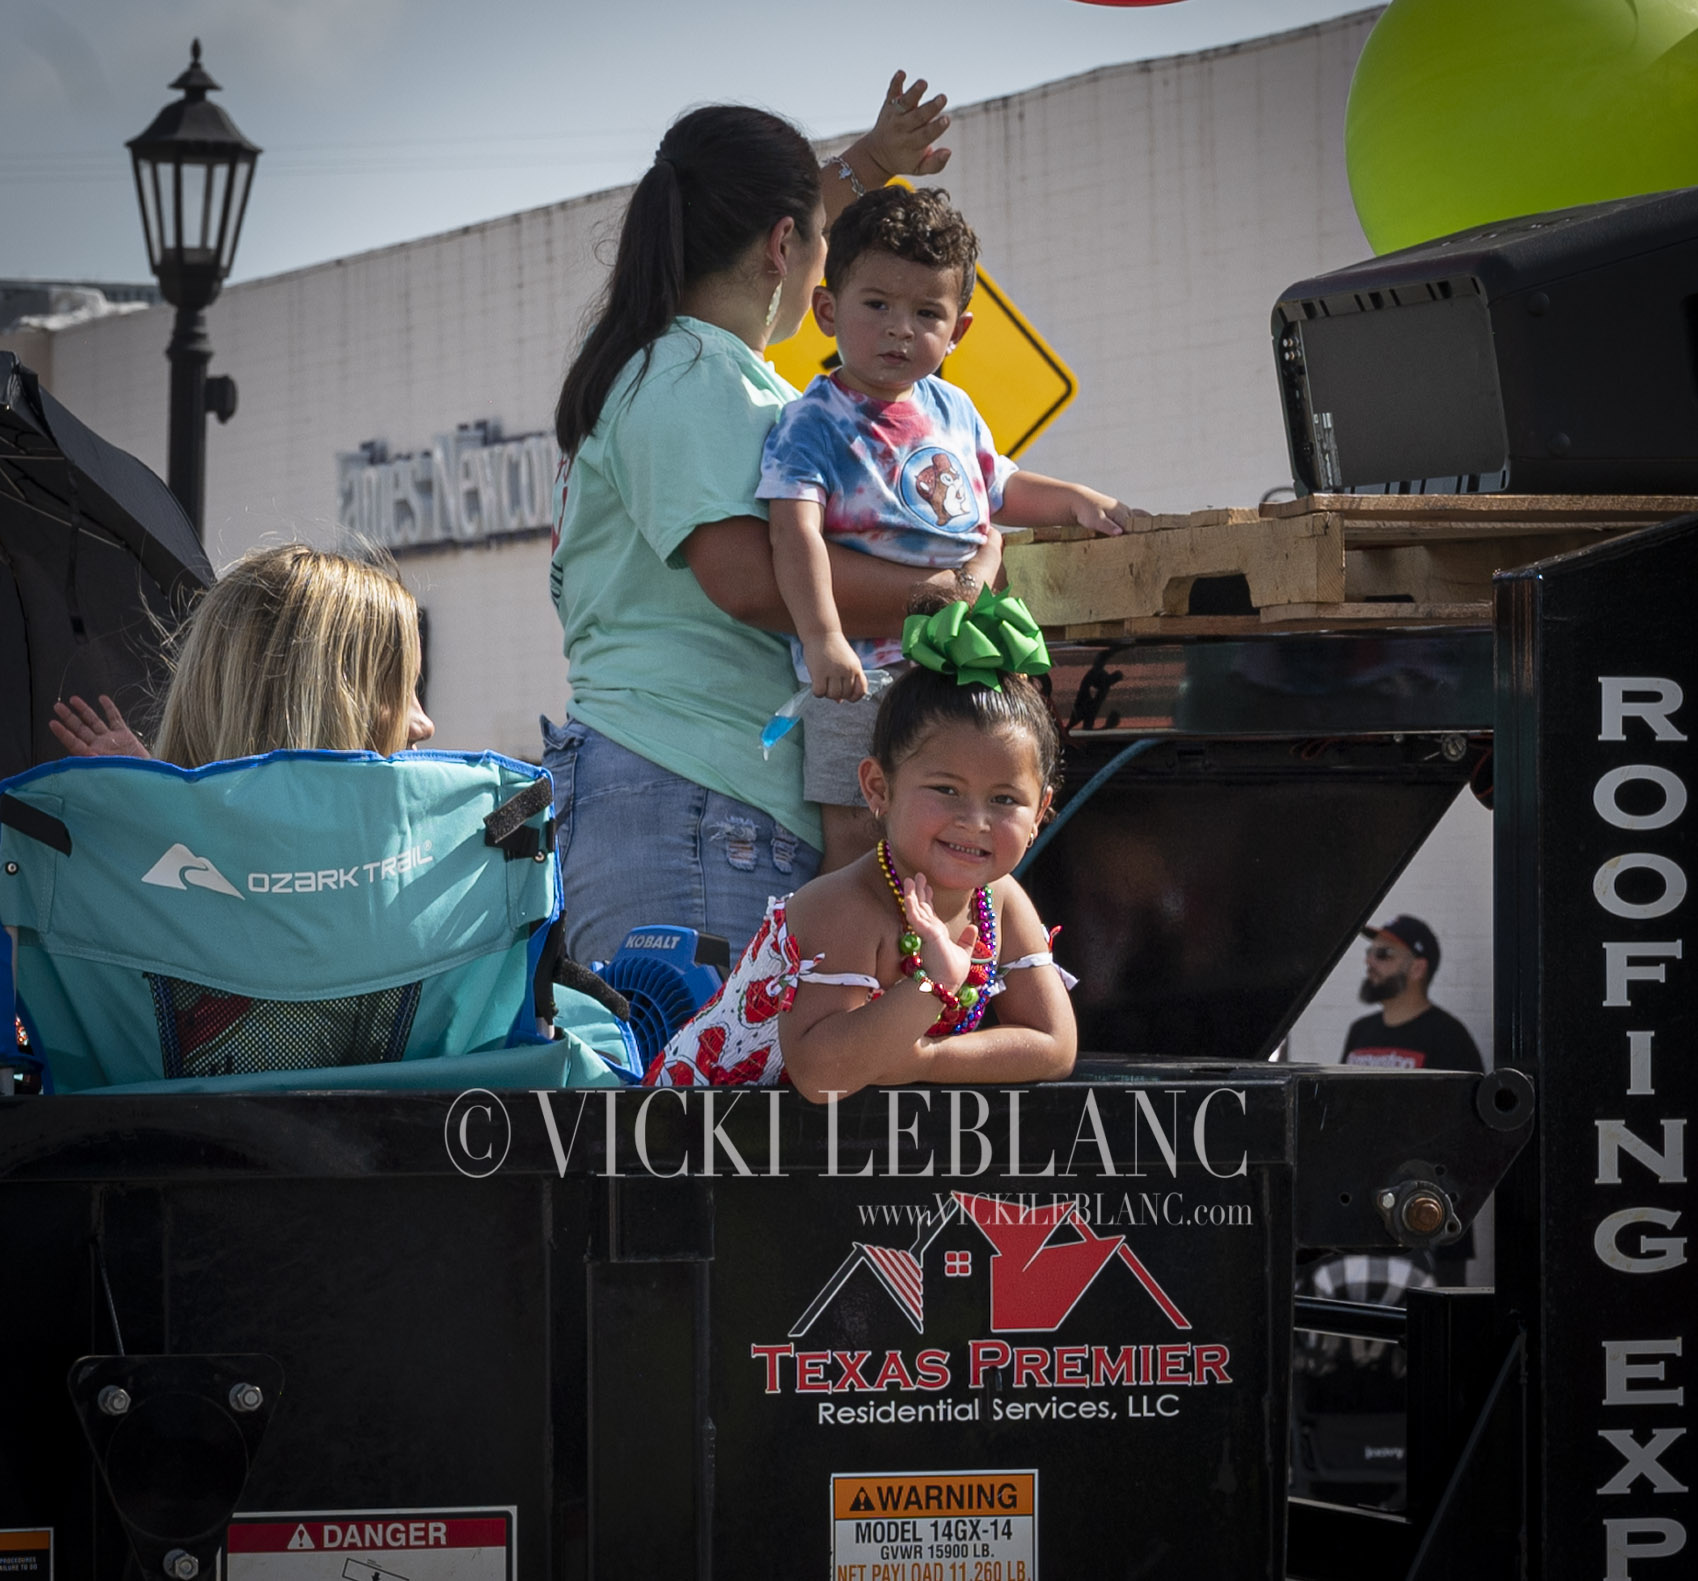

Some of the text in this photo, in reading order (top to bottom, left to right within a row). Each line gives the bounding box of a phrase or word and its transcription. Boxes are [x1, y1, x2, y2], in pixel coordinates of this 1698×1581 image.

[625, 934, 681, 950] KOBALT
[1593, 676, 1689, 1581] ROOFING EXP
[751, 1339, 1233, 1394] TEXAS PREMIER
[818, 1394, 1180, 1425] Residential Services, LLC
[876, 1483, 1017, 1511] WARNING
[323, 1522, 447, 1548] DANGER
[855, 1518, 1013, 1544] MODEL 14GX-14
[880, 1543, 995, 1560] GVWR 15900 LB.
